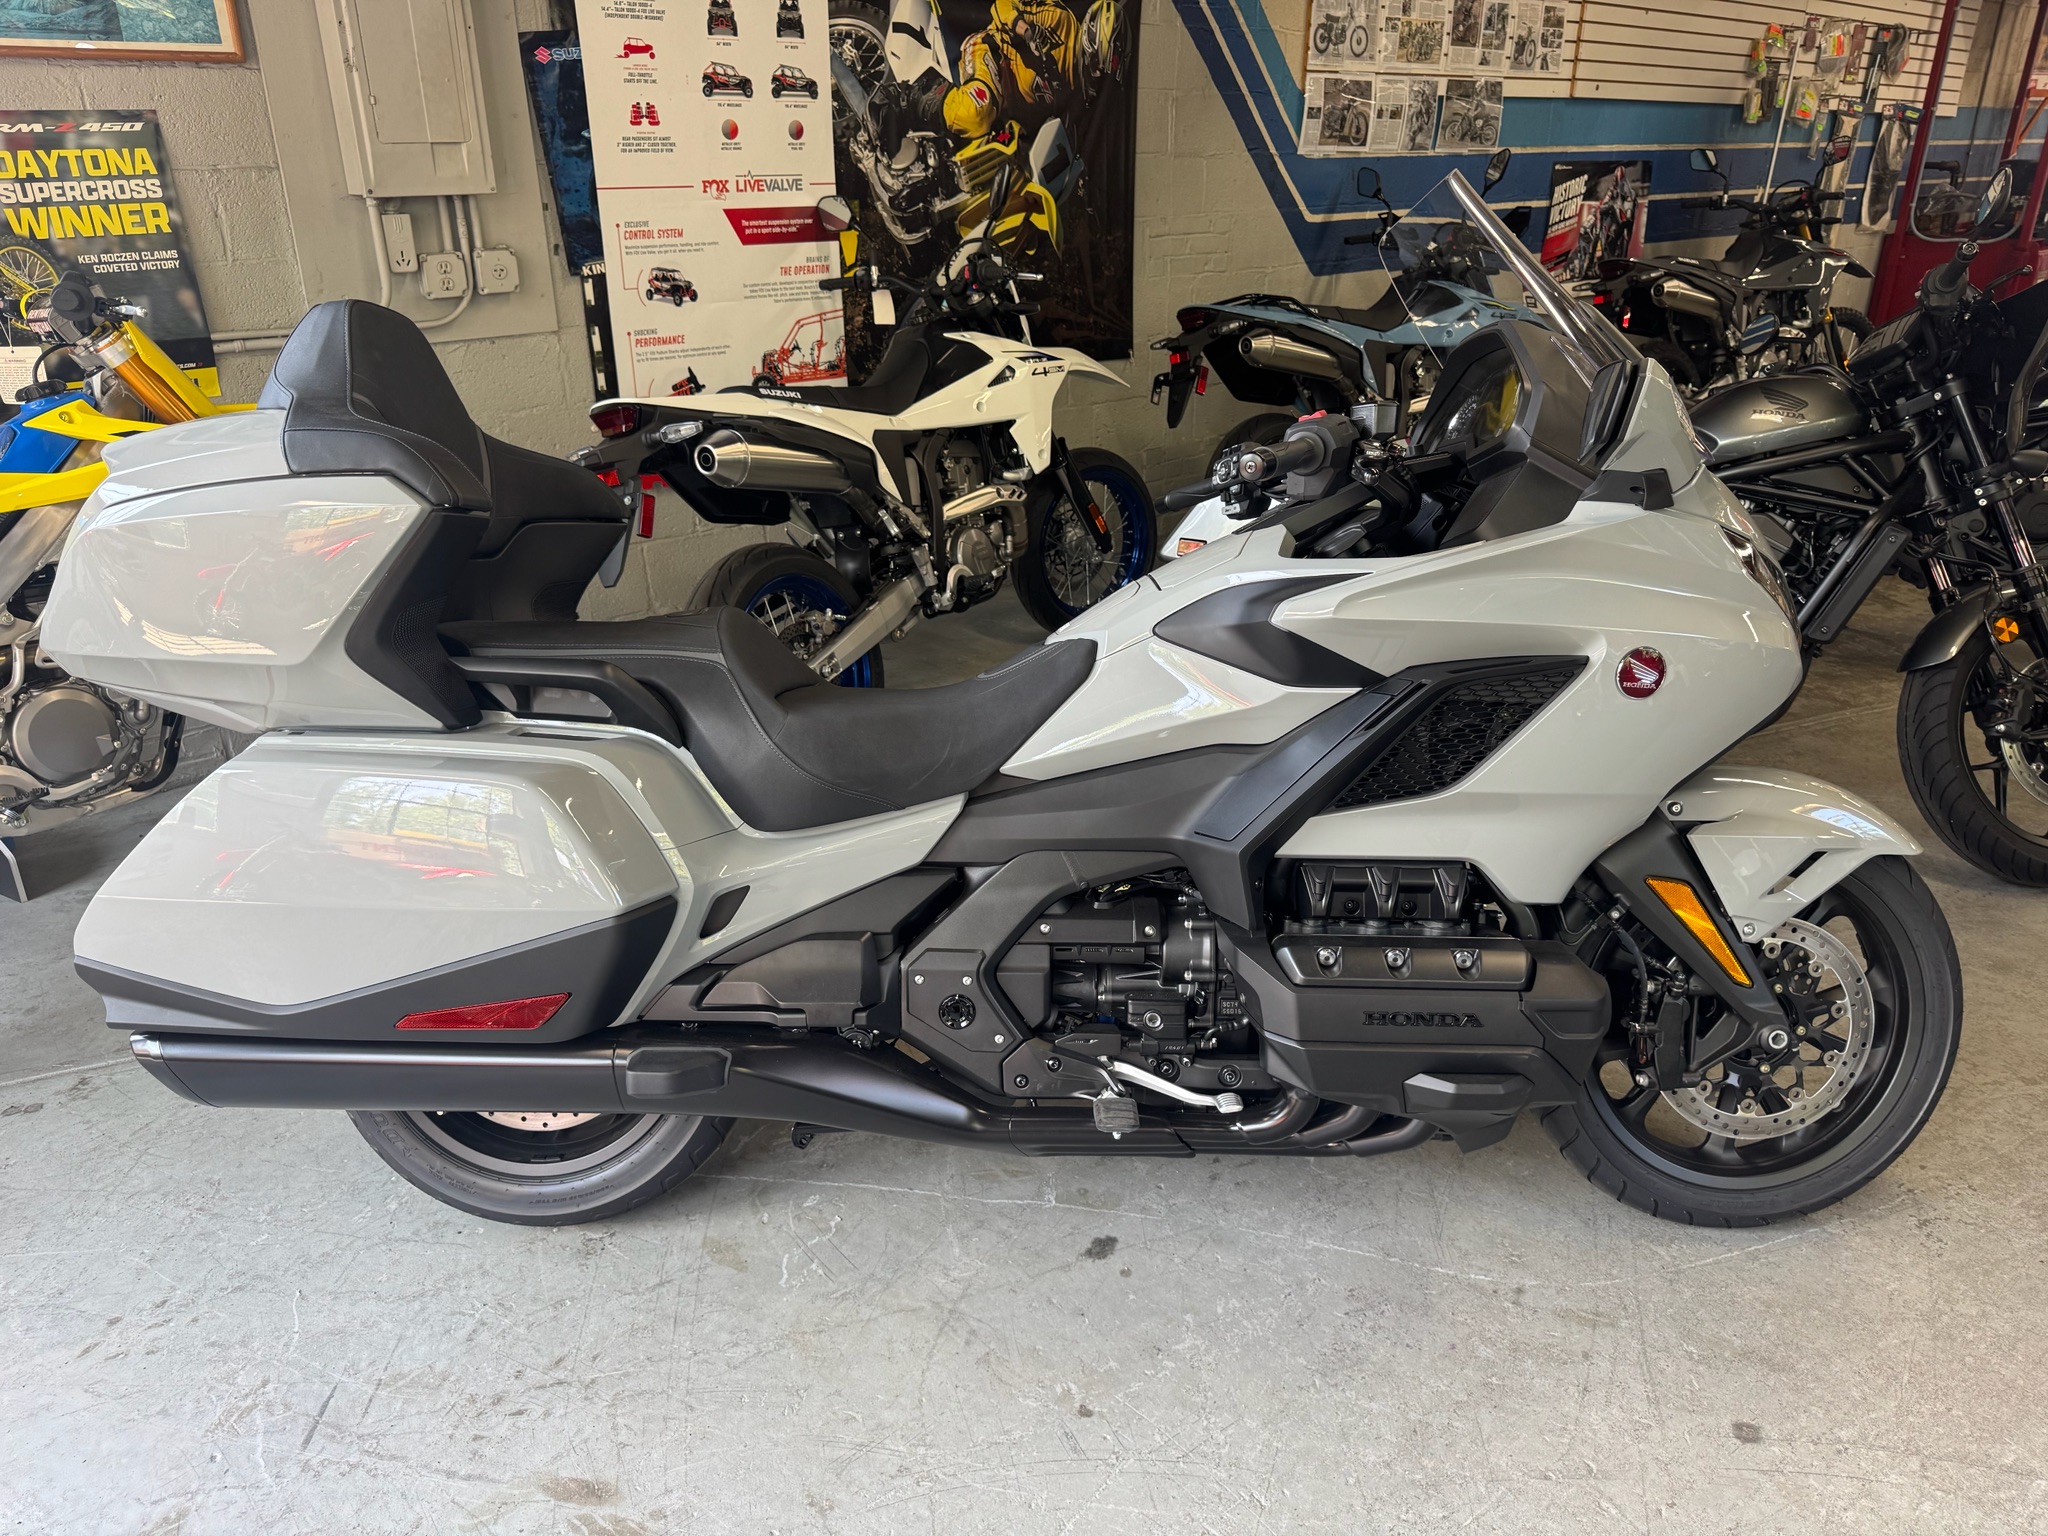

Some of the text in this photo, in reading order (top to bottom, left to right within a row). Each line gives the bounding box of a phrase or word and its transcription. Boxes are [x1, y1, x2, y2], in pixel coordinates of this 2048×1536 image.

[0, 148, 158, 178] DAYTONA
[0, 179, 163, 204] SUPERCROSS
[702, 180, 730, 194] FOX
[1552, 174, 1588, 206] HISTORIC
[1549, 194, 1584, 226] VICTORY
[4, 202, 172, 240] WINNER
[624, 228, 683, 240] CONTROL SYSTEM
[78, 250, 178, 264] KEN ROCZEN CLAIMS
[93, 260, 180, 274] COVETED VICTORY
[780, 264, 830, 276] THE OPERATION
[634, 328, 658, 337] SHOCKING
[635, 335, 685, 348] PERFORMANCE
[759, 388, 802, 399] SUZUKI
[1752, 409, 1806, 420] HONDA
[1362, 1012, 1484, 1028] HONDA
